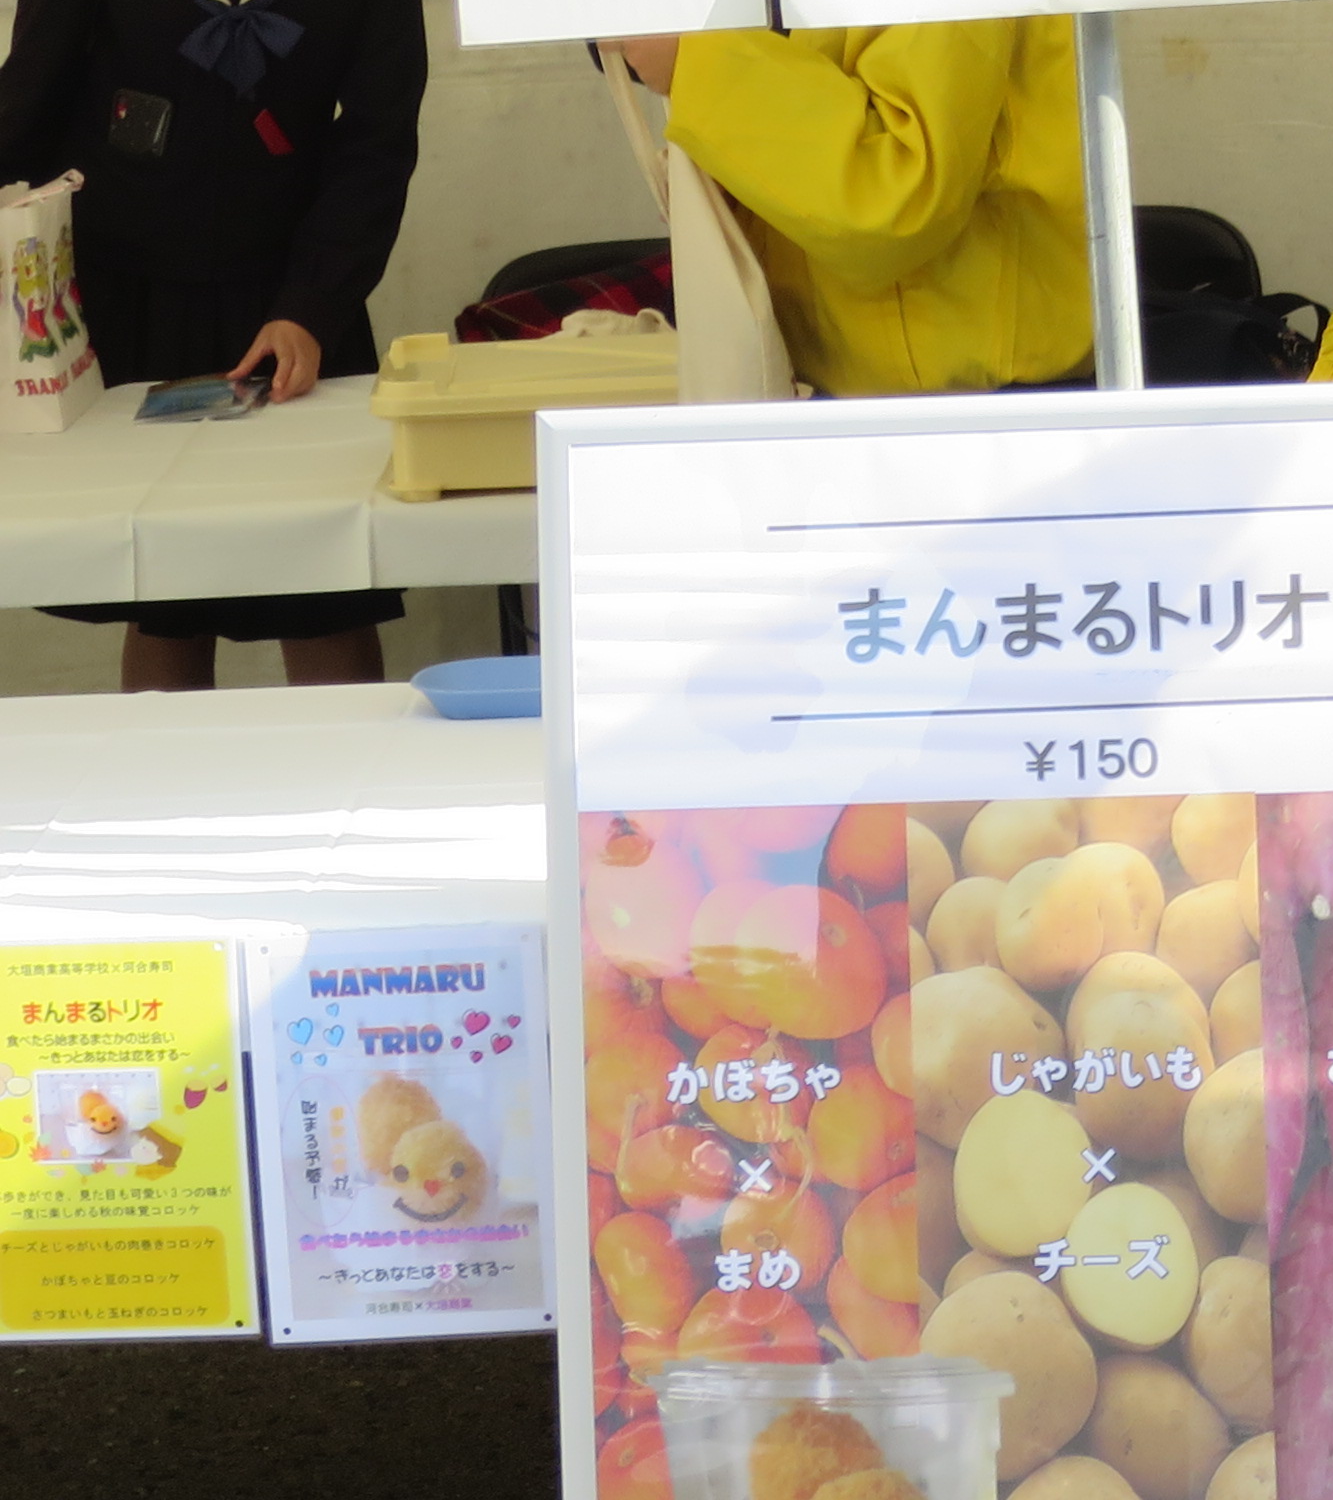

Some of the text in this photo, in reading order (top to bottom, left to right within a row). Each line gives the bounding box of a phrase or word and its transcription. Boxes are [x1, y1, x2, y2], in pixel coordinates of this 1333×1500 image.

[837, 573, 1330, 665] まんまるトリオ
[1025, 738, 1159, 782] ¥150
[309, 963, 486, 999] MANMARU
[22, 998, 163, 1024] まんまるトリオ
[358, 1023, 444, 1056] TRIO
[666, 1060, 842, 1106] かぼちゃ
[988, 1046, 1203, 1095] じゃがいも
[713, 1246, 803, 1292] まめ
[1034, 1236, 1171, 1282] チーズ
